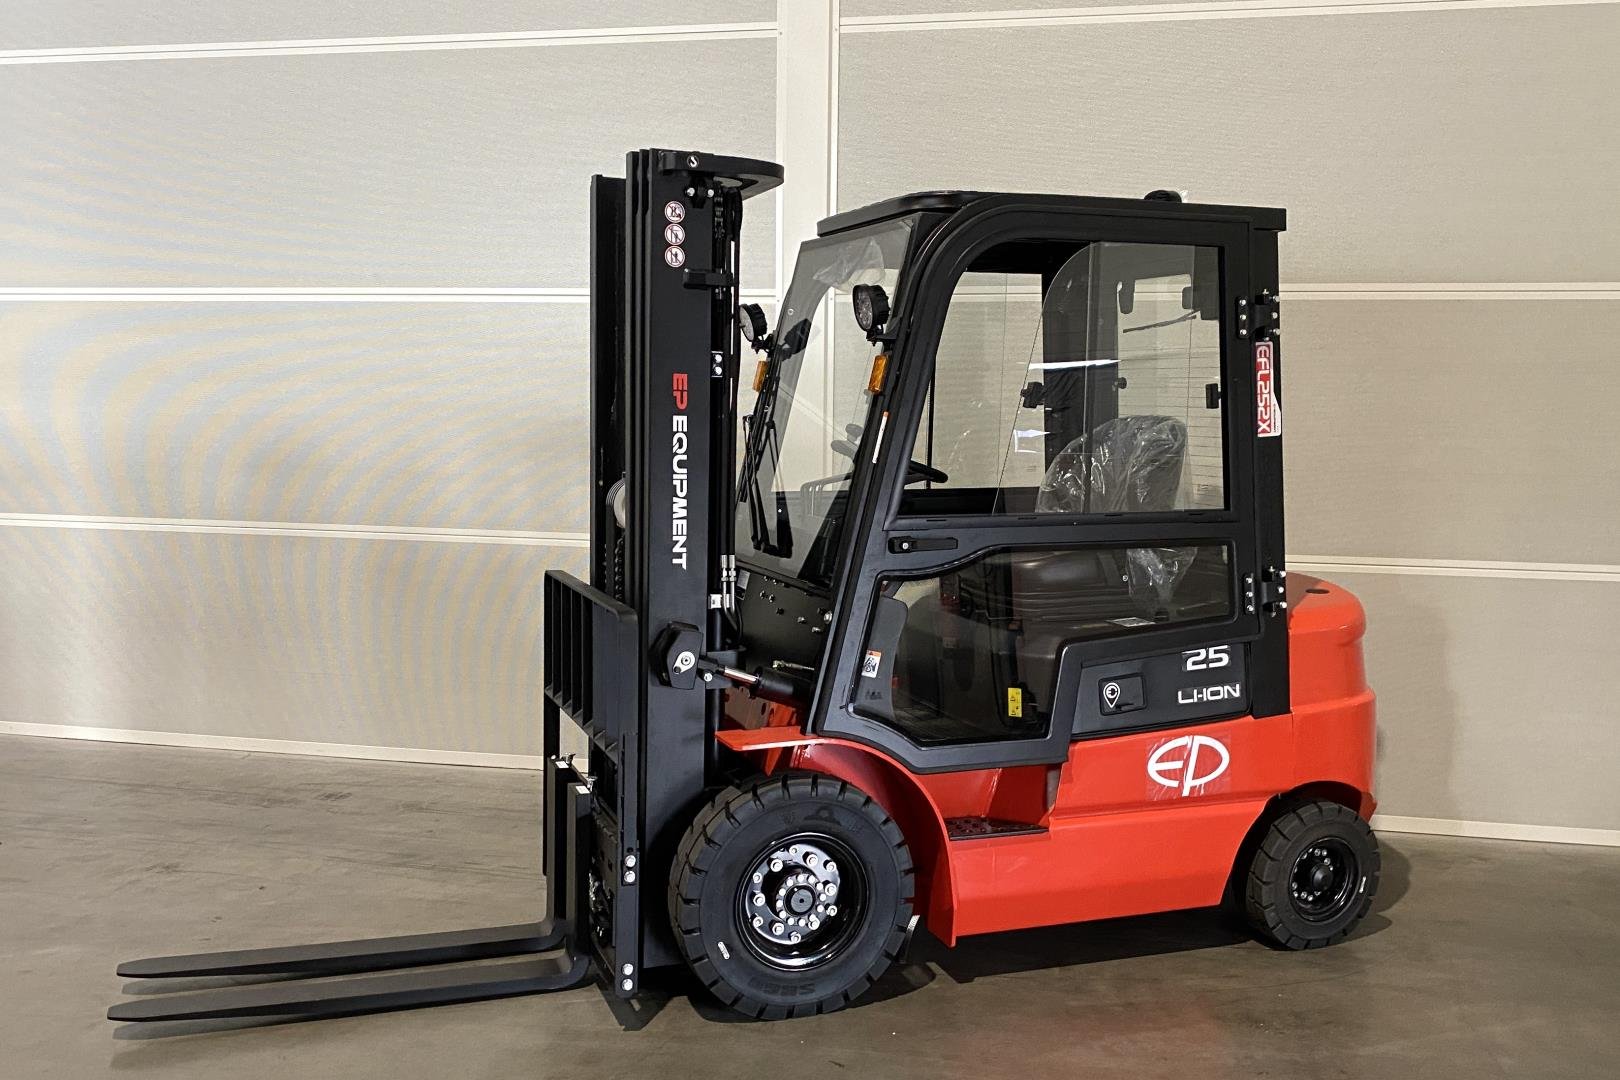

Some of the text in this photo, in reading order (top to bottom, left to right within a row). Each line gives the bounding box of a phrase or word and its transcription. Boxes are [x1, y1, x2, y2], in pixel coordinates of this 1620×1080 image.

[1256, 345, 1271, 433] EFL252X
[672, 373, 688, 570] EP EQUIPMENT
[1182, 645, 1230, 671] 25
[1147, 735, 1230, 797] EP
